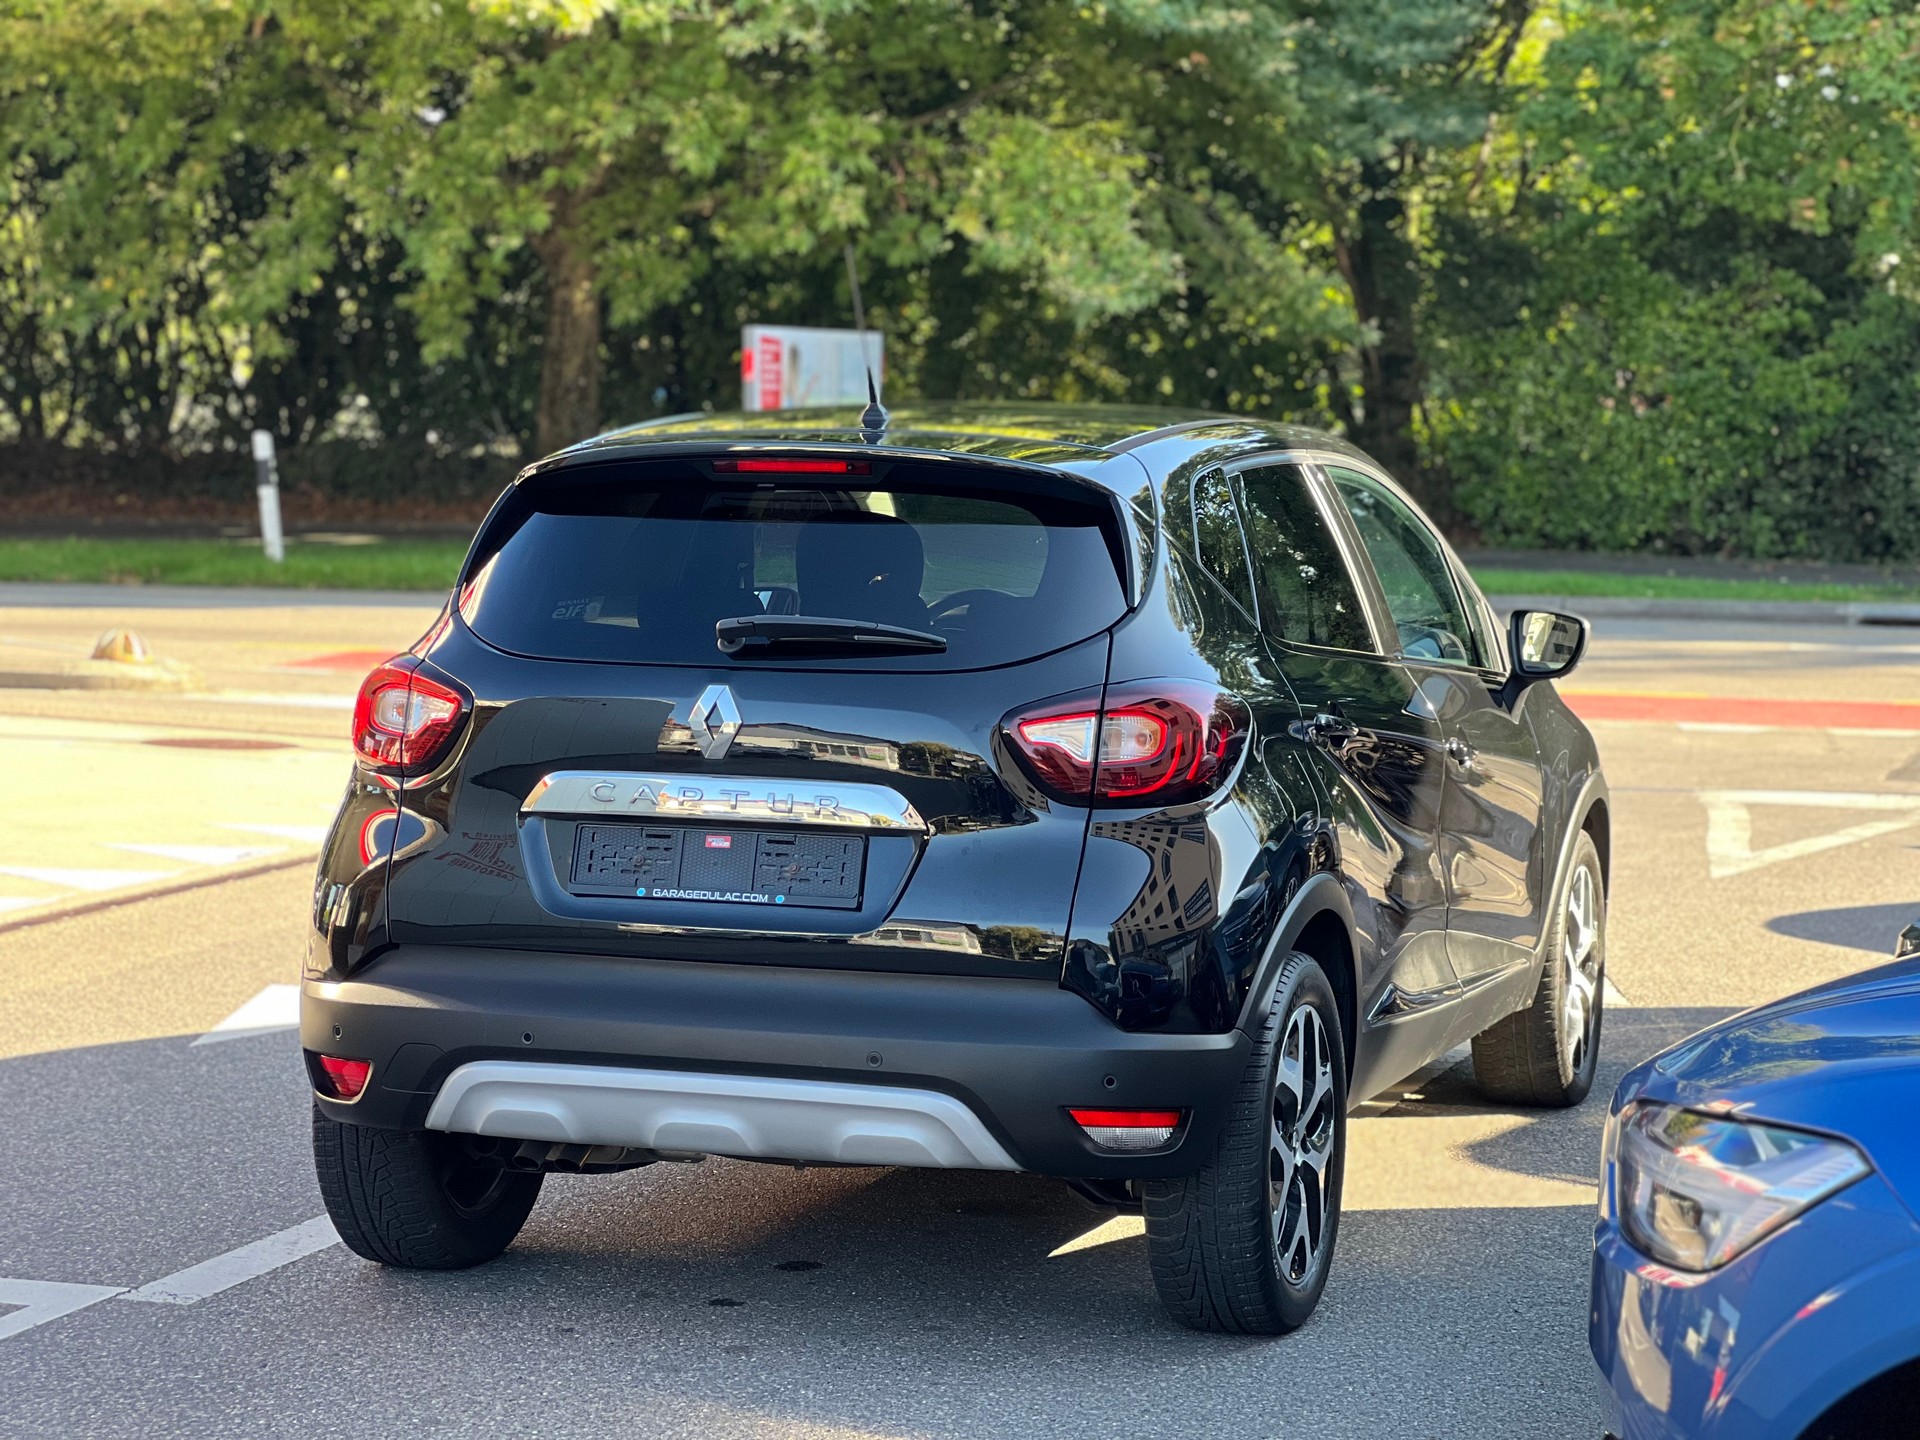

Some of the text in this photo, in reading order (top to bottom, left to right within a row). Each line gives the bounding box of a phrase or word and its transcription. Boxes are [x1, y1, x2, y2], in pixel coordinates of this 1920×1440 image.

[552, 604, 585, 619] elf
[589, 783, 841, 816] CAPTUR
[652, 888, 768, 903] GARAGEDULAC.COM
